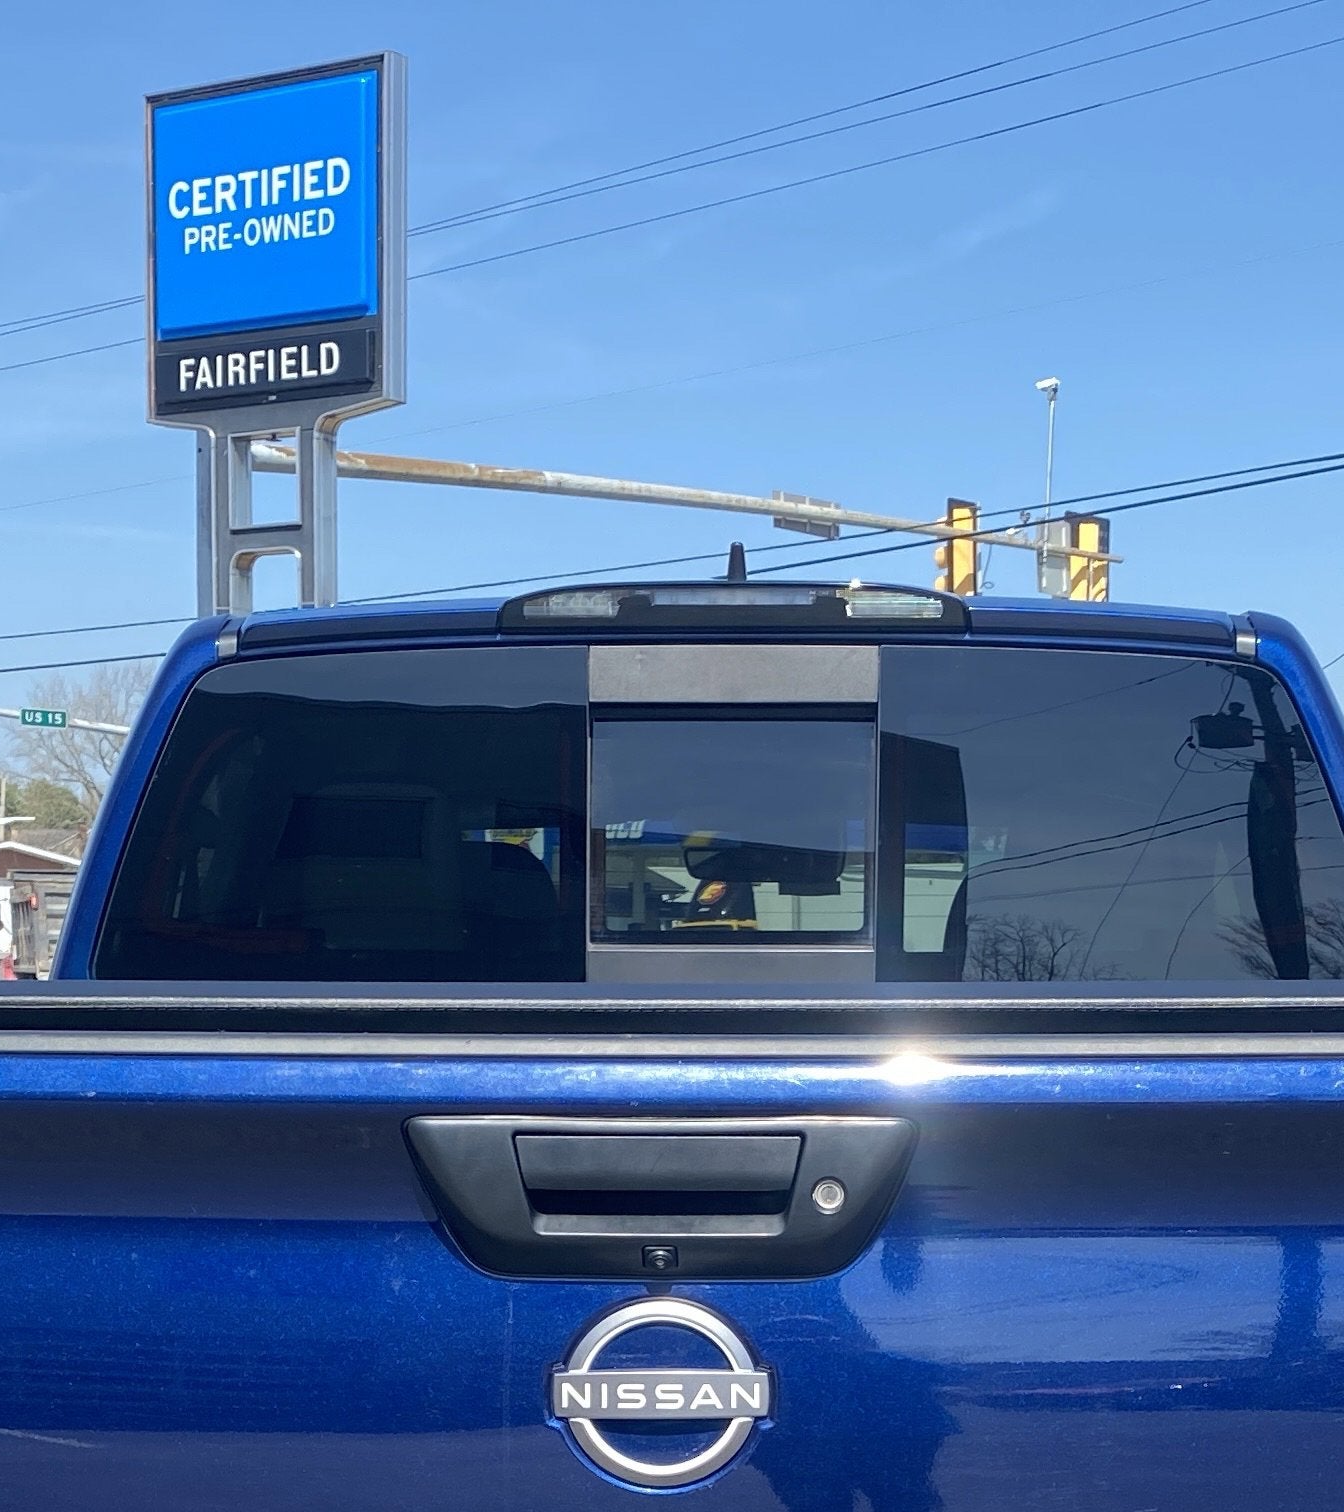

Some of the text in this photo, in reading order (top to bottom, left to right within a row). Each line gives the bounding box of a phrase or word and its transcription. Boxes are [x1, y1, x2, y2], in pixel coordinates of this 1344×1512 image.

[168, 156, 351, 220] CERTIFIED
[183, 208, 336, 255] PRE-OWNED
[178, 340, 341, 393] FAIRFIELD
[25, 711, 62, 724] US 15
[560, 1382, 761, 1410] NISSAN
